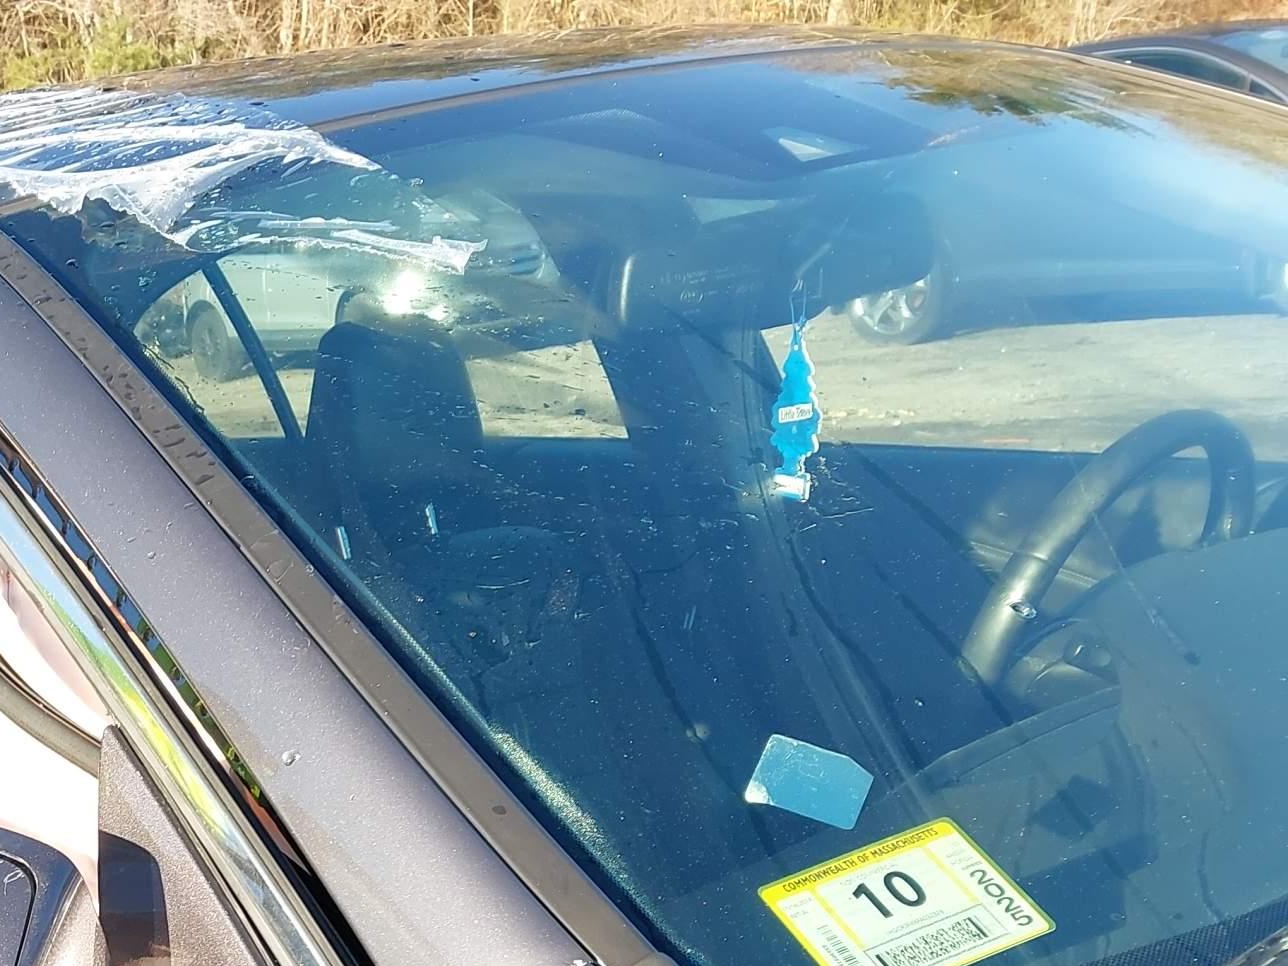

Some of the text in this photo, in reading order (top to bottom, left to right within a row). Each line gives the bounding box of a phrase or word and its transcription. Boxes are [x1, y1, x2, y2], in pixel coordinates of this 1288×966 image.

[782, 858, 857, 893] COMMONWEALTH
[857, 852, 870, 864] OF
[871, 827, 939, 859] MASSACHUSETTS
[852, 870, 927, 919] 10
[969, 869, 1034, 926] 2025
